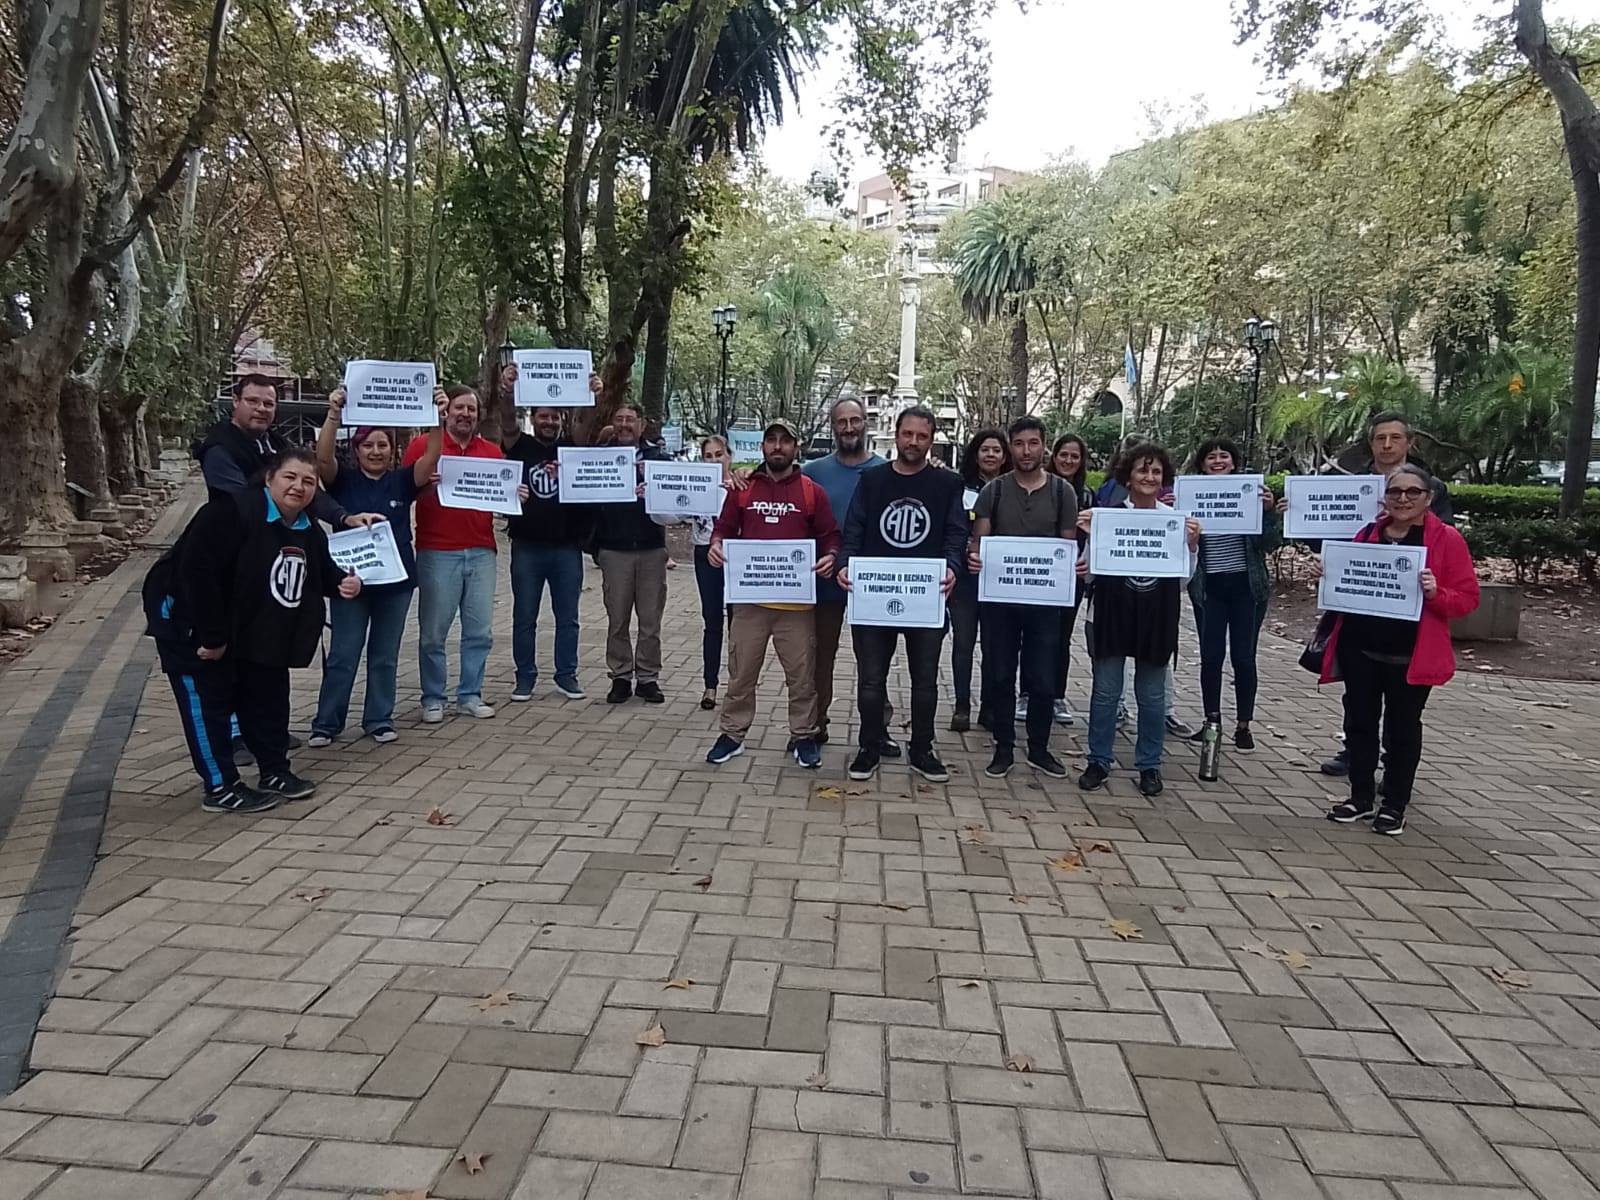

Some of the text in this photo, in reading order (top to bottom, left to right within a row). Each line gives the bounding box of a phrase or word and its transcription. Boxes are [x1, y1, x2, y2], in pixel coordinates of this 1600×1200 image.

[885, 504, 925, 543] ATE
[1141, 528, 1166, 537] MÍNIMO
[1030, 556, 1053, 565] MÍNIMO
[858, 573, 895, 581] ACEPTACION
[1024, 578, 1055, 587] MUNICIPAL
[868, 585, 902, 593] MUNICIPAL
